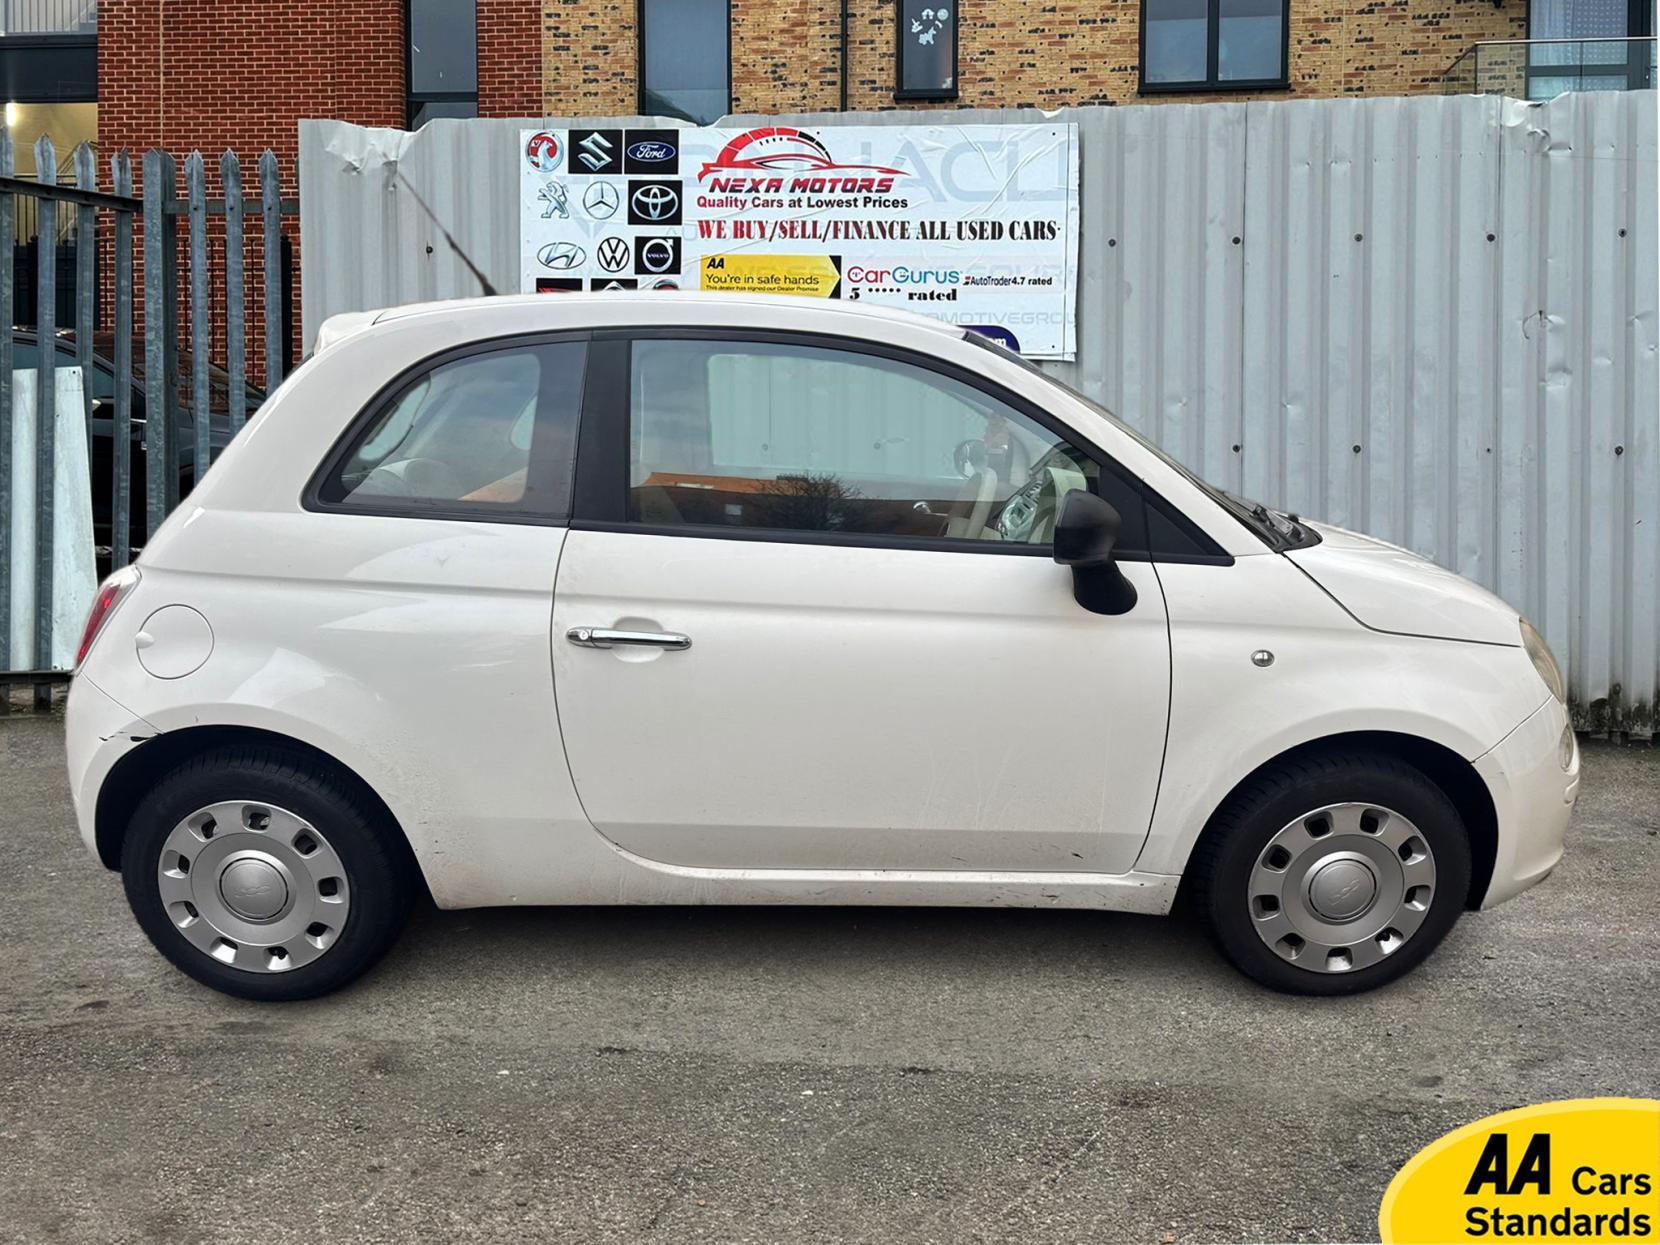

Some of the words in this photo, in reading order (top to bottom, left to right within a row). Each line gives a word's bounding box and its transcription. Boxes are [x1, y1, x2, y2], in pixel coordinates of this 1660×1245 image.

[636, 144, 666, 159] Ford
[709, 178, 784, 193] NEXA
[789, 178, 895, 193] MOTORS
[697, 196, 749, 210] Quality
[752, 196, 784, 208] Cars
[788, 197, 803, 208] at
[807, 196, 859, 208] Lowest
[863, 196, 908, 208] Prices
[698, 220, 726, 239] WE
[916, 220, 950, 240] ALL
[957, 220, 1003, 240] USED
[1009, 220, 1056, 240] CARS
[707, 257, 725, 269] AA
[706, 274, 741, 284] You're
[744, 274, 754, 284] in
[757, 274, 781, 284] safe
[784, 275, 819, 285] hands
[847, 266, 959, 284] CarGurus
[1028, 276, 1052, 285] rated
[849, 287, 860, 300] 5
[908, 288, 957, 300] rated
